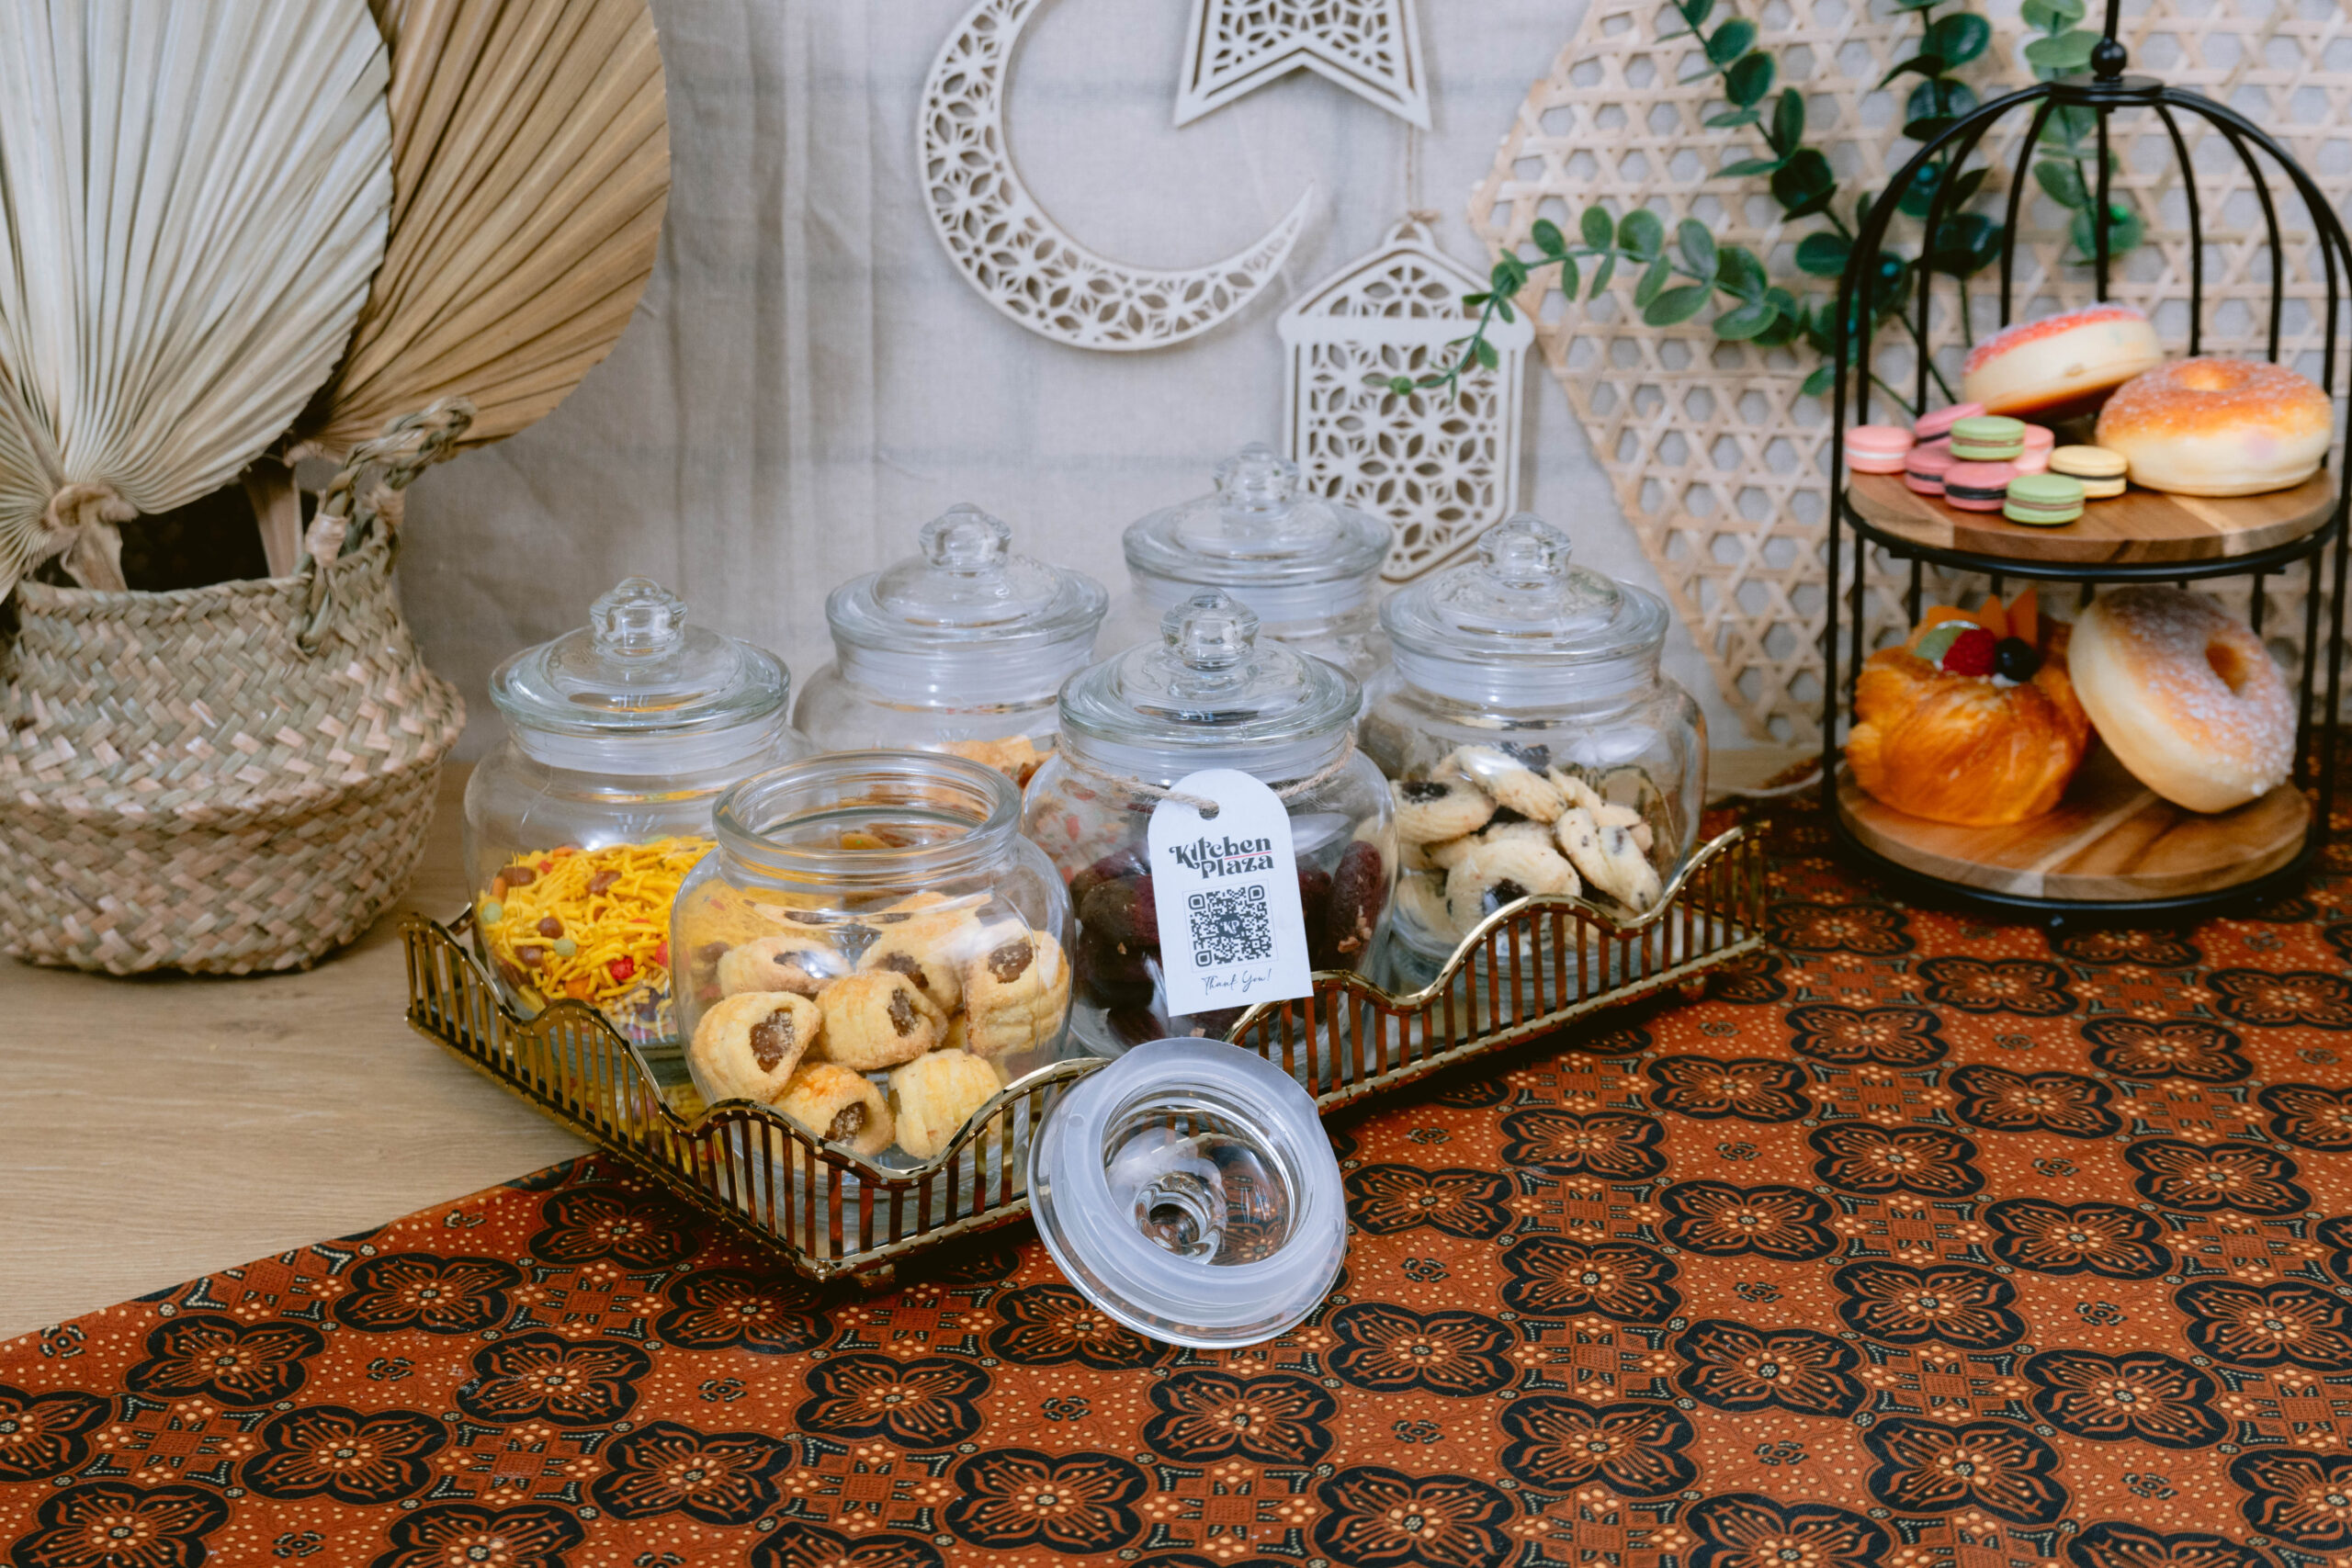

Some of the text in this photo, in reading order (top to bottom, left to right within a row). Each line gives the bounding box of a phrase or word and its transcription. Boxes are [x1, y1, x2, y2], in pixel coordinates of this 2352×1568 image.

[1169, 836, 1272, 870] Kitchen
[1201, 855, 1274, 879] Plaza
[1219, 919, 1240, 937] KP
[1201, 968, 1272, 996] Thank You!
